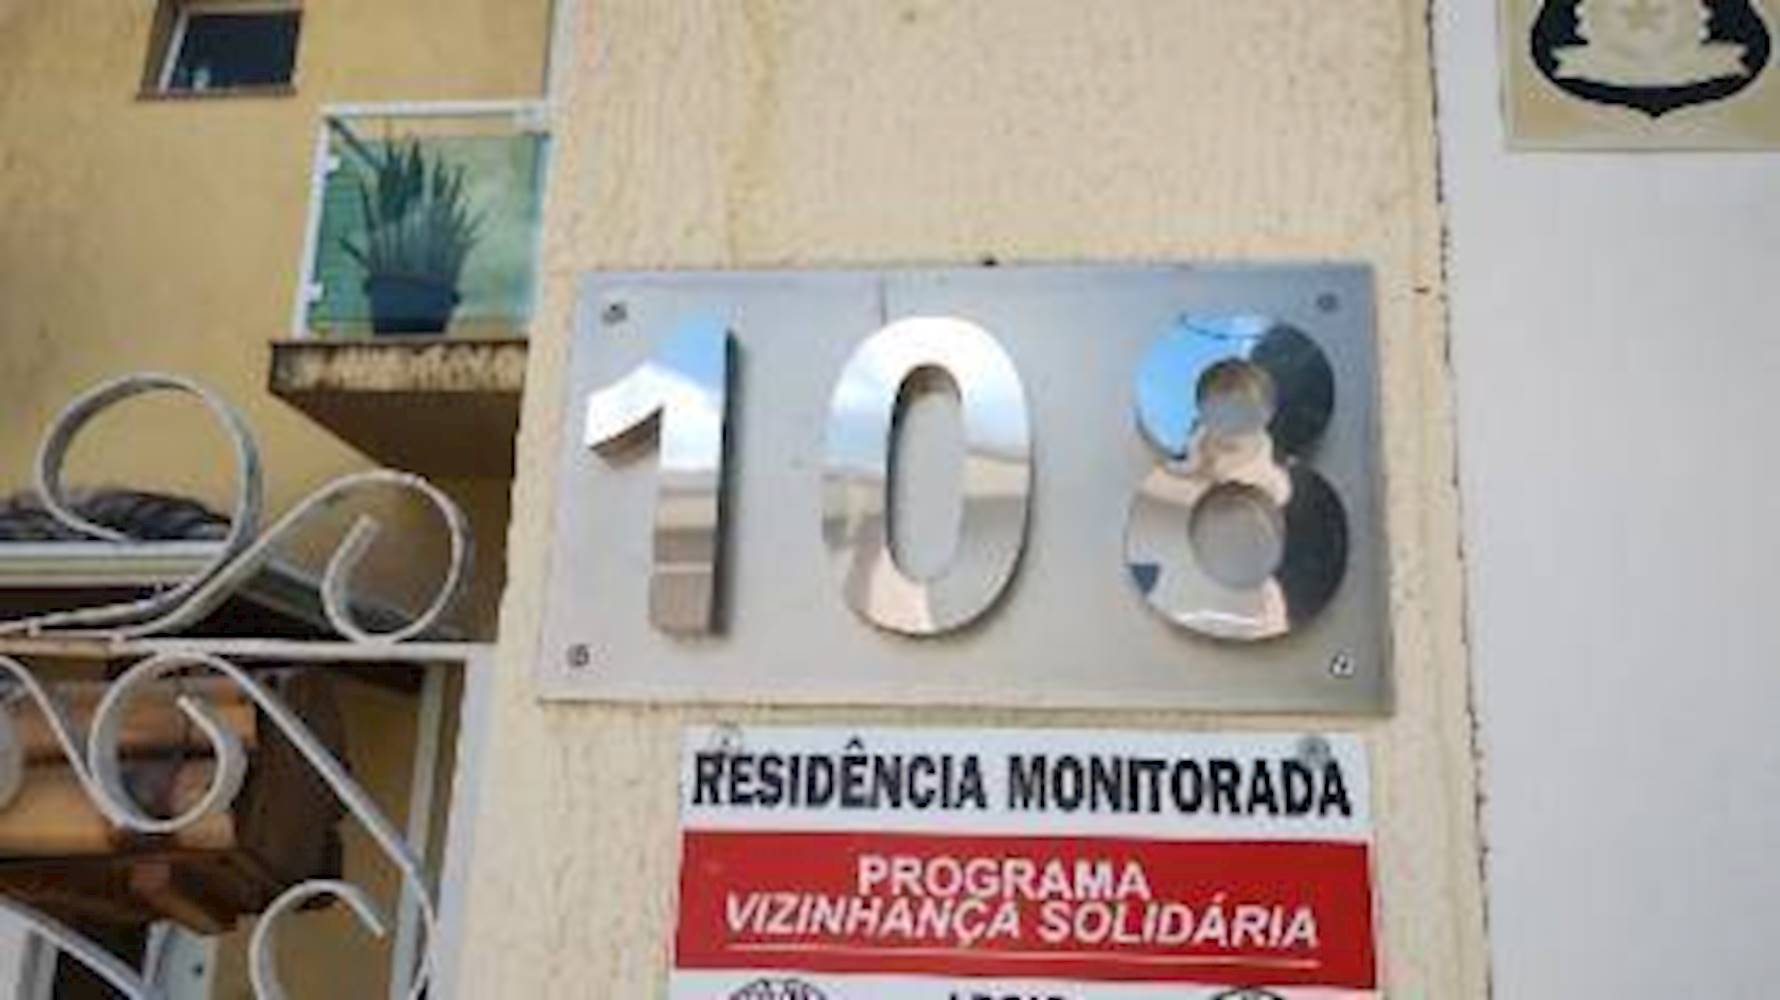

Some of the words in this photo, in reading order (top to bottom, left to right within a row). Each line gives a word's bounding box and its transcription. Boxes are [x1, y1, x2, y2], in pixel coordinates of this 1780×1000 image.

[584, 310, 1350, 643] 108
[691, 737, 987, 811] RESIDÊNCIA
[1008, 754, 1353, 818] MONITORADA
[856, 854, 1151, 900] PROGRAMA
[725, 892, 1022, 944] VIZINHANÇA
[1038, 894, 1319, 948] SOLIDÁRIA
